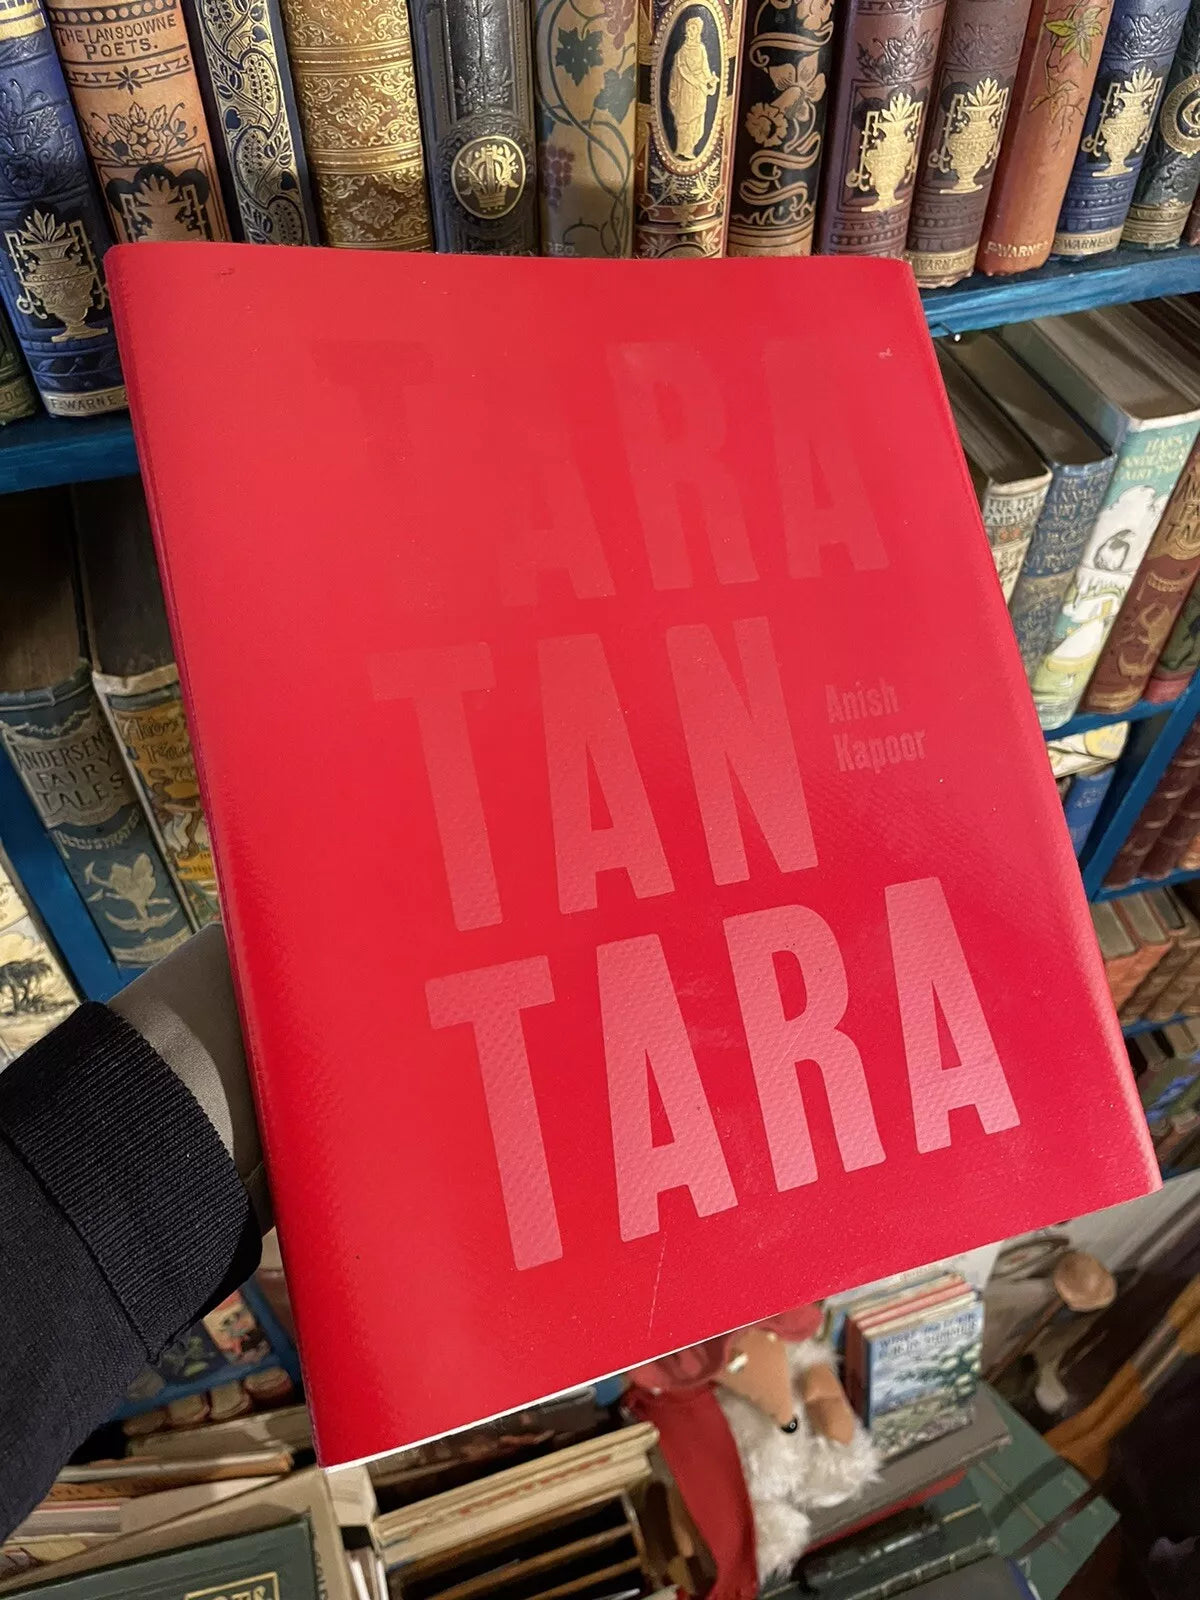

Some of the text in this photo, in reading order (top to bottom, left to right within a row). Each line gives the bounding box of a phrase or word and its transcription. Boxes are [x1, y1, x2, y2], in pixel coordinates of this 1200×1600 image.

[56, 13, 177, 47] THE LANSDOWNE
[84, 37, 159, 60] POETS.
[308, 336, 890, 612] TARA
[825, 676, 899, 723] Anish
[36, 749, 114, 789] FAIRY
[366, 616, 818, 931] TAN
[833, 729, 926, 775] Kapoor
[37, 770, 126, 811] TALES
[425, 876, 1021, 1271] TARA
